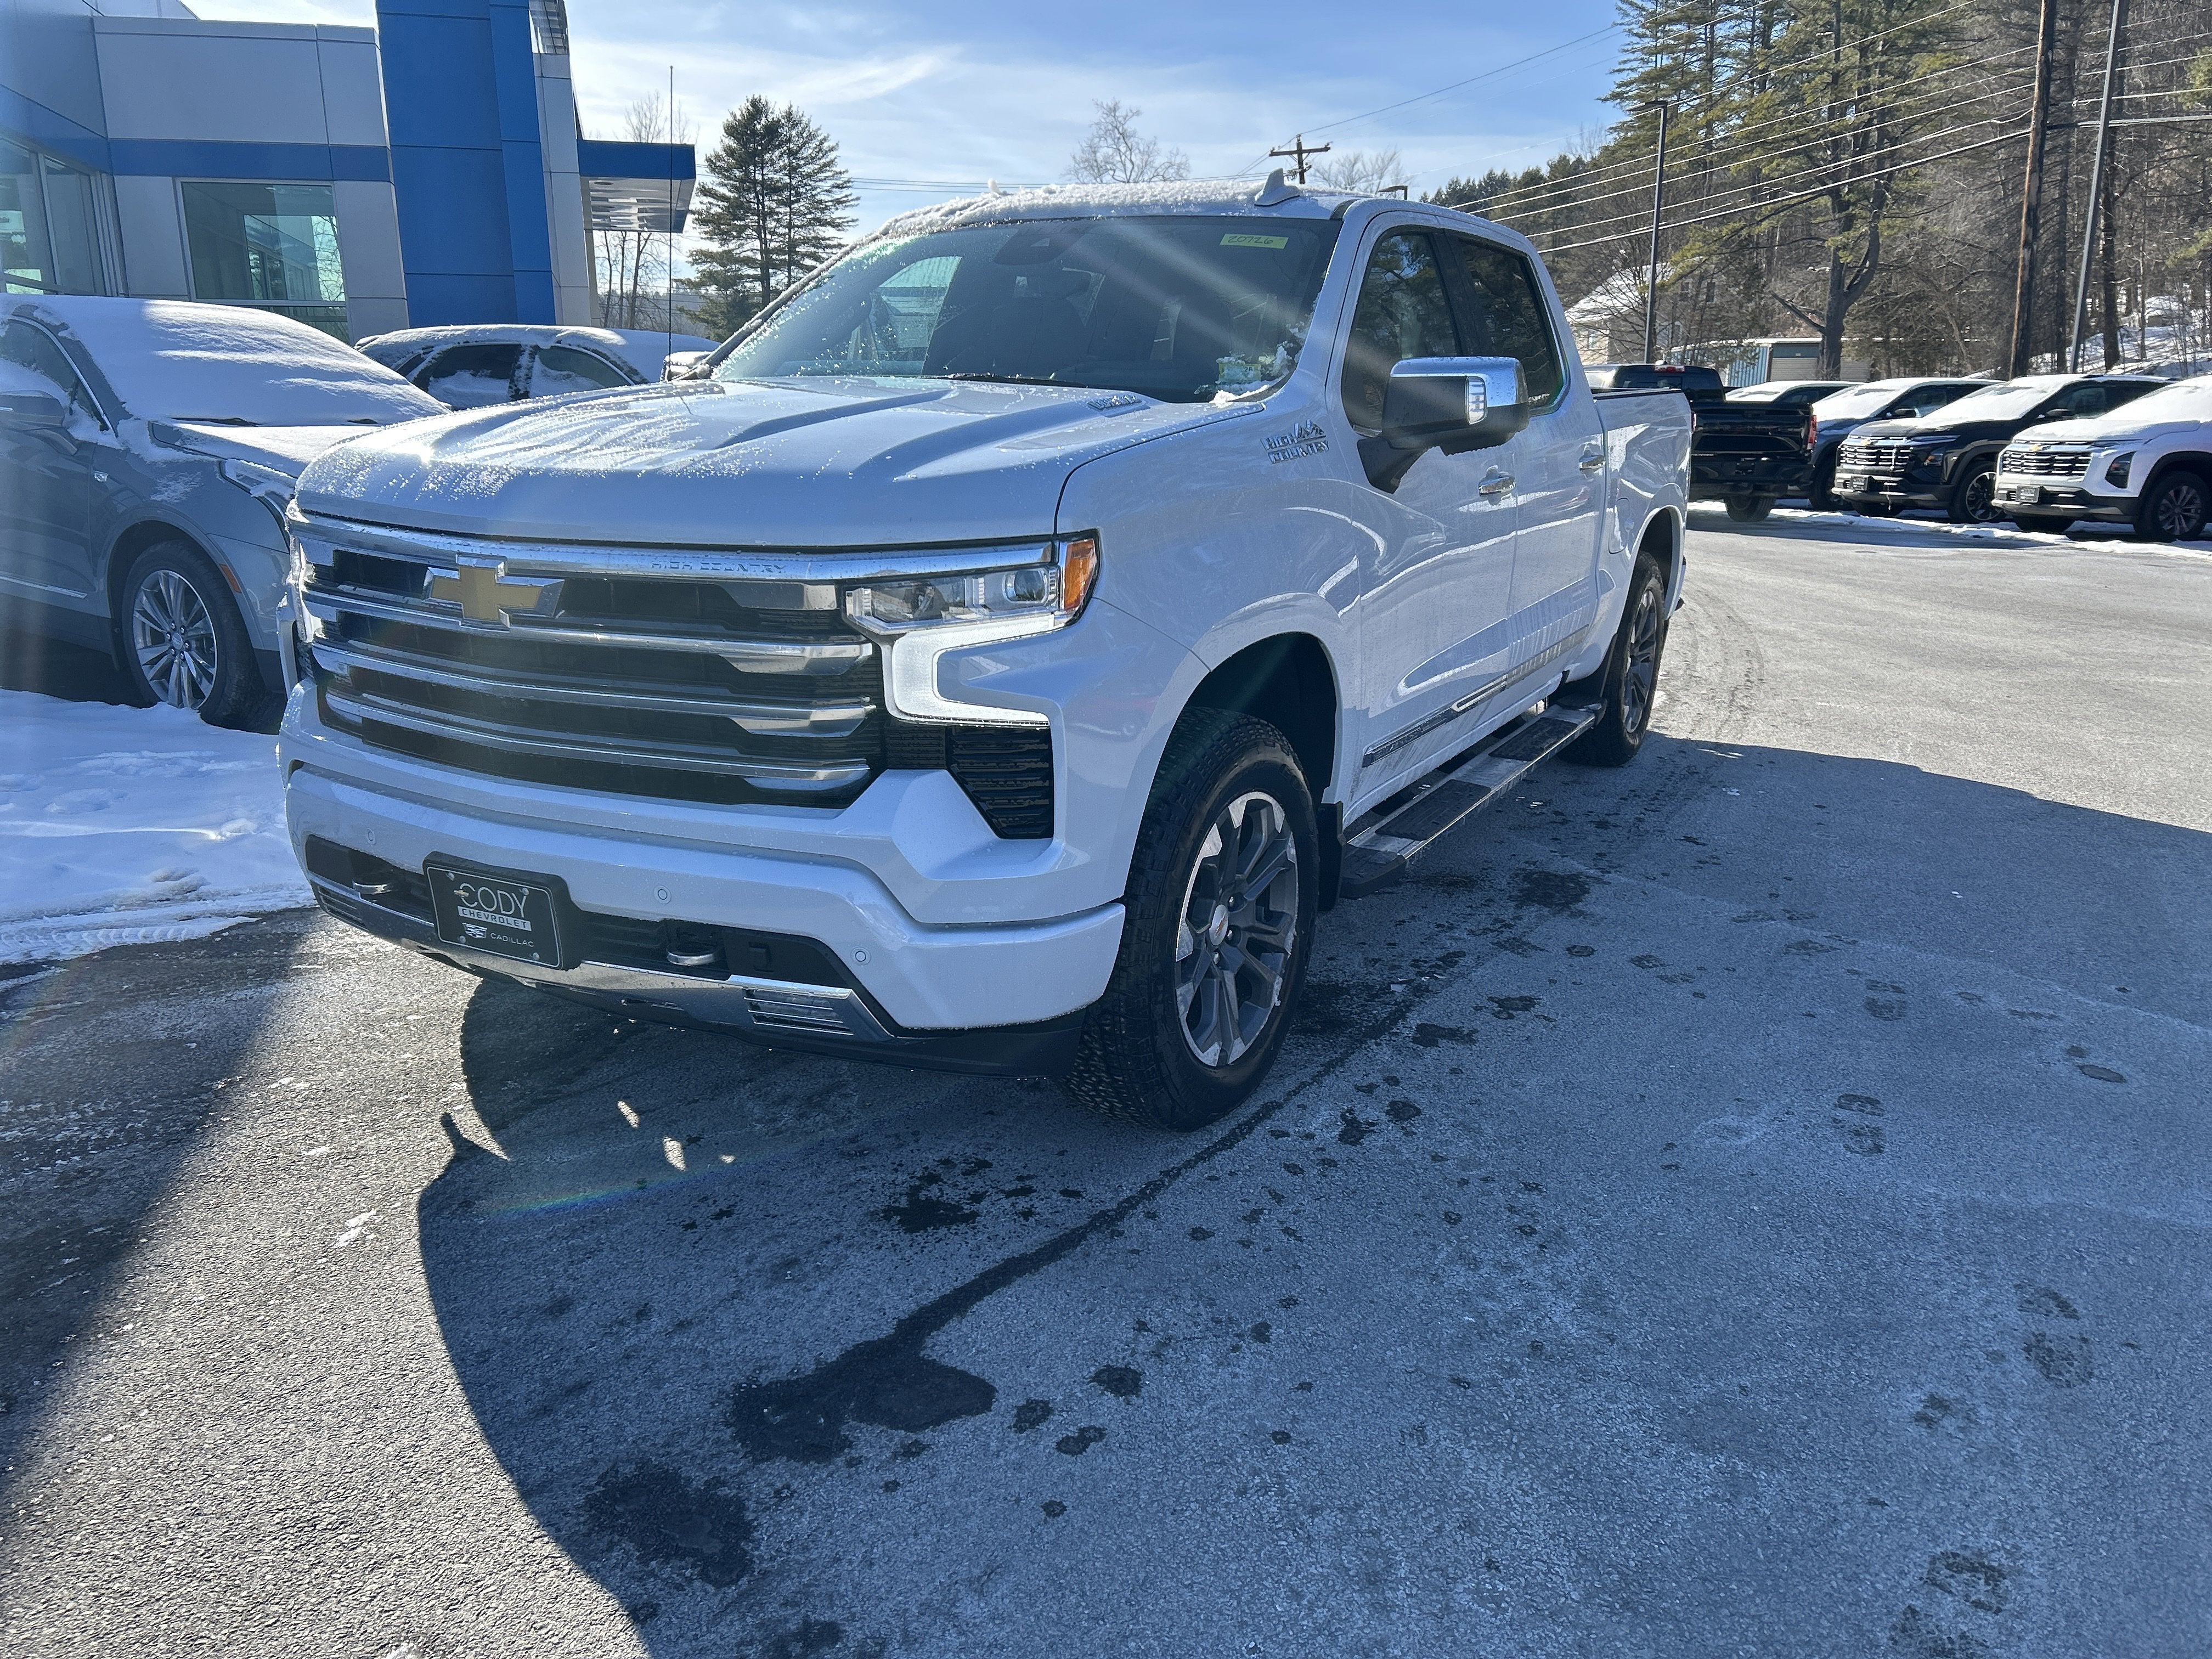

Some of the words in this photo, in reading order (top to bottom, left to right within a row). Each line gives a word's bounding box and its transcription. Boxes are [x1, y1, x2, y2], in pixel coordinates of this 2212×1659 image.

[651, 560, 692, 570] HIGH
[699, 562, 786, 573] COUNTRY
[459, 883, 528, 918] CODY
[461, 908, 527, 928] CHEVROLET
[490, 933, 535, 947] CADILLAC
